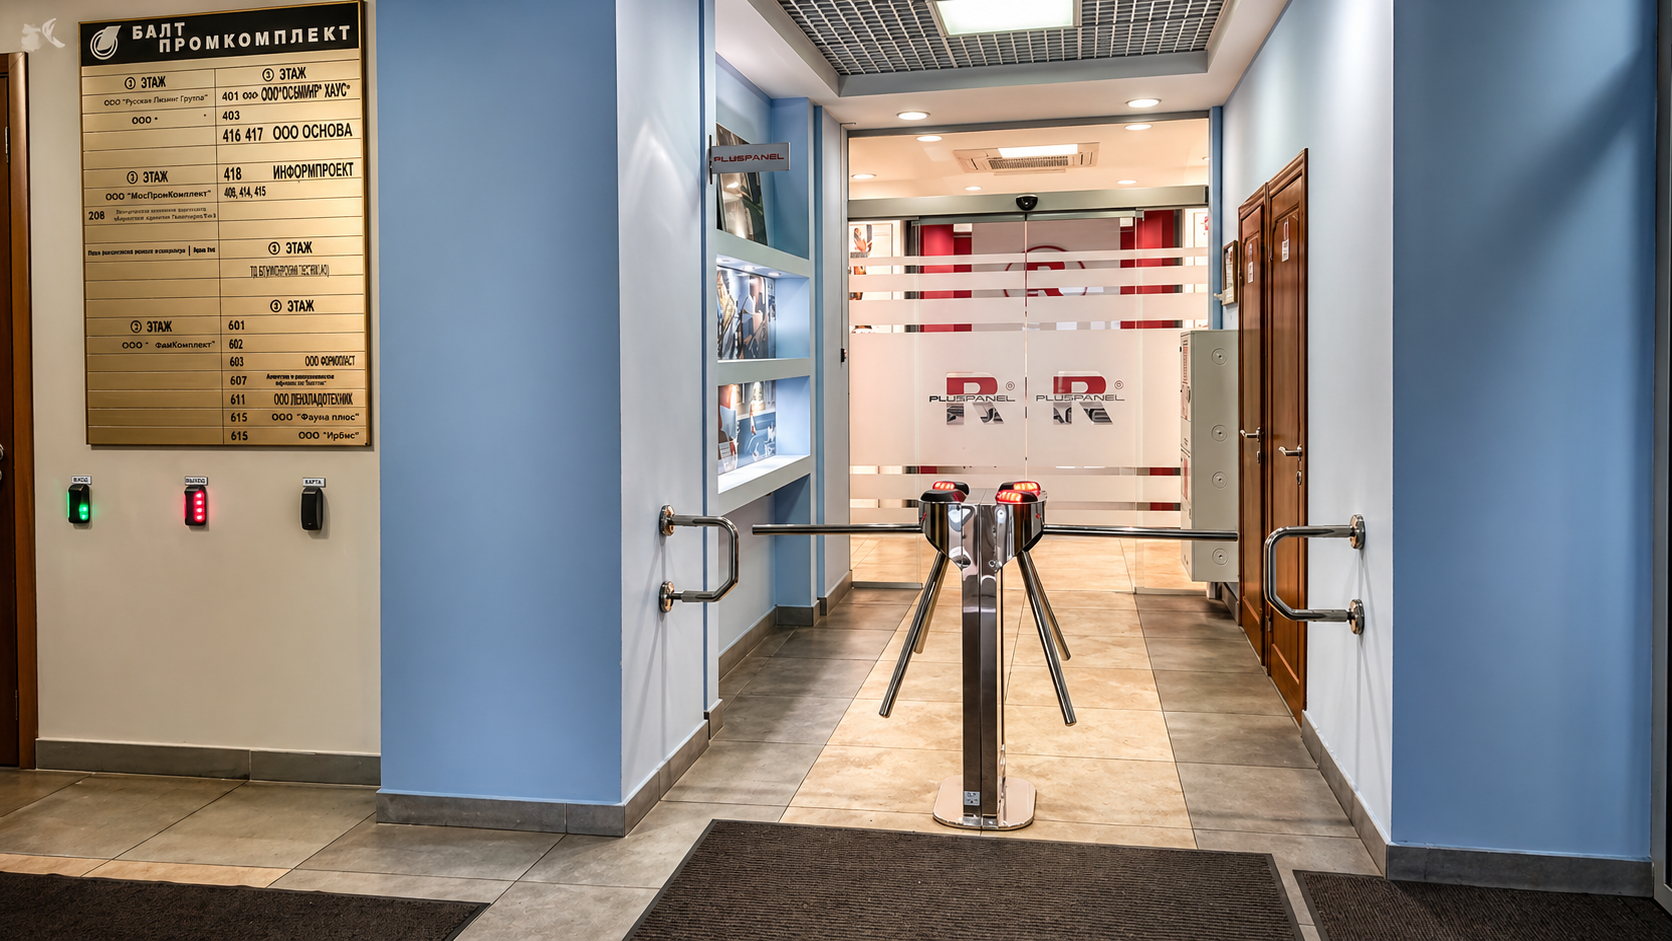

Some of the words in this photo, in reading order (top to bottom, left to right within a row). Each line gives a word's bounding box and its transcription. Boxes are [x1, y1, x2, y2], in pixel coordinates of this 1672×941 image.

[132, 21, 186, 40] БАЛТ
[159, 25, 351, 53] ПРОМКОМПЛЕКТ
[279, 67, 307, 80] ЭТАЖ
[141, 76, 166, 89] ЭТАЖ
[222, 91, 239, 101] 401
[222, 110, 240, 121] 403
[223, 128, 241, 142] 416
[245, 127, 263, 142] 417
[272, 125, 299, 140] ООО
[302, 122, 353, 139] ОСНОВА
[714, 153, 785, 162] PLUSPANEL
[143, 170, 169, 183] ЭТАЖ
[223, 166, 242, 181] 418
[273, 162, 354, 180] ИНФОРМПРОЕКТ
[88, 210, 105, 221] 208
[285, 241, 313, 254] ЭТАЖ
[287, 300, 315, 313] ЭТАЖ
[146, 320, 173, 333] ЭТАЖ
[228, 320, 245, 331] 601
[228, 338, 243, 349] 602
[229, 356, 244, 367] 603
[230, 375, 247, 386] 607
[230, 394, 245, 405] 611
[929, 394, 1016, 403] PLUSPANEL
[1035, 394, 1125, 402] PLUSPANEL
[230, 412, 248, 423] 615
[271, 413, 293, 421] ООО
[231, 431, 248, 441] 615
[298, 431, 320, 440] ООО
